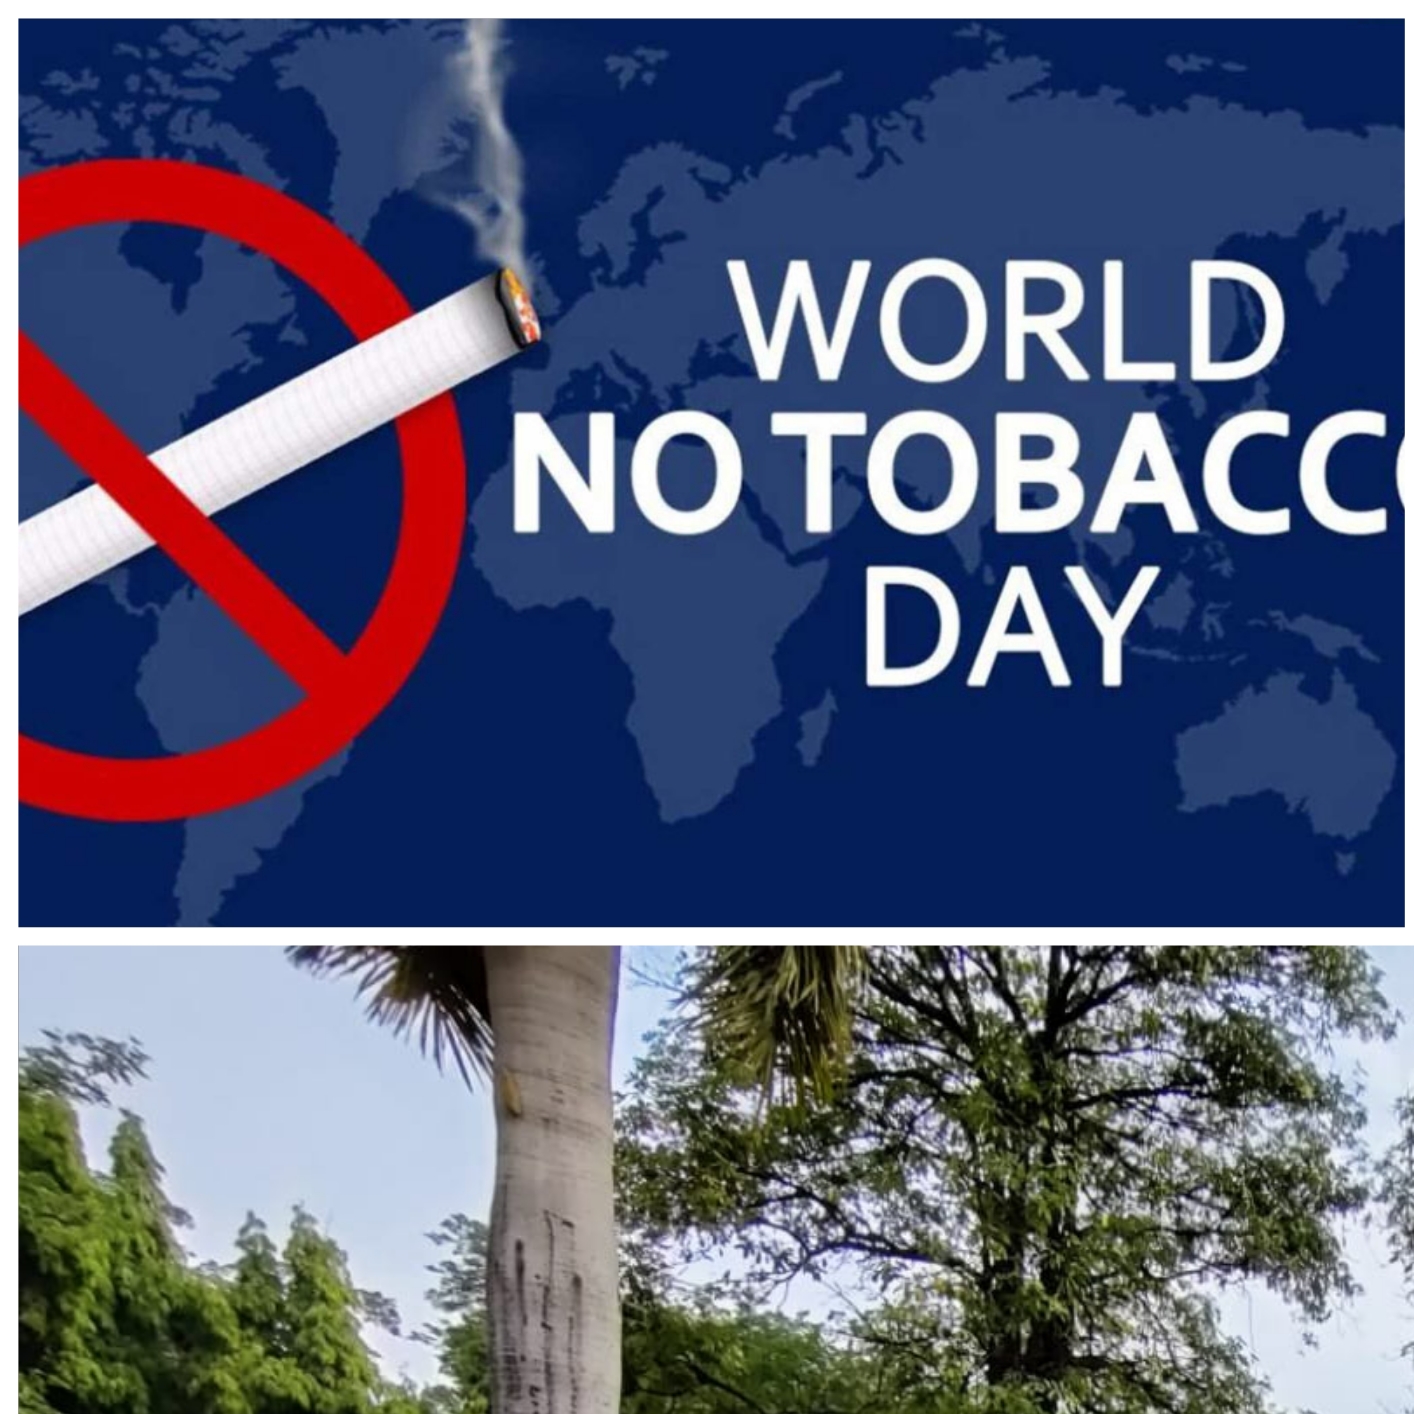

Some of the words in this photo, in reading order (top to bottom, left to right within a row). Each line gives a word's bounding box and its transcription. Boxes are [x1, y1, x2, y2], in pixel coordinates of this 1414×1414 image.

[726, 257, 1286, 383] WORLD
[513, 409, 743, 536] NO
[771, 409, 1405, 536] TOBACC
[865, 565, 1161, 688] DAY
